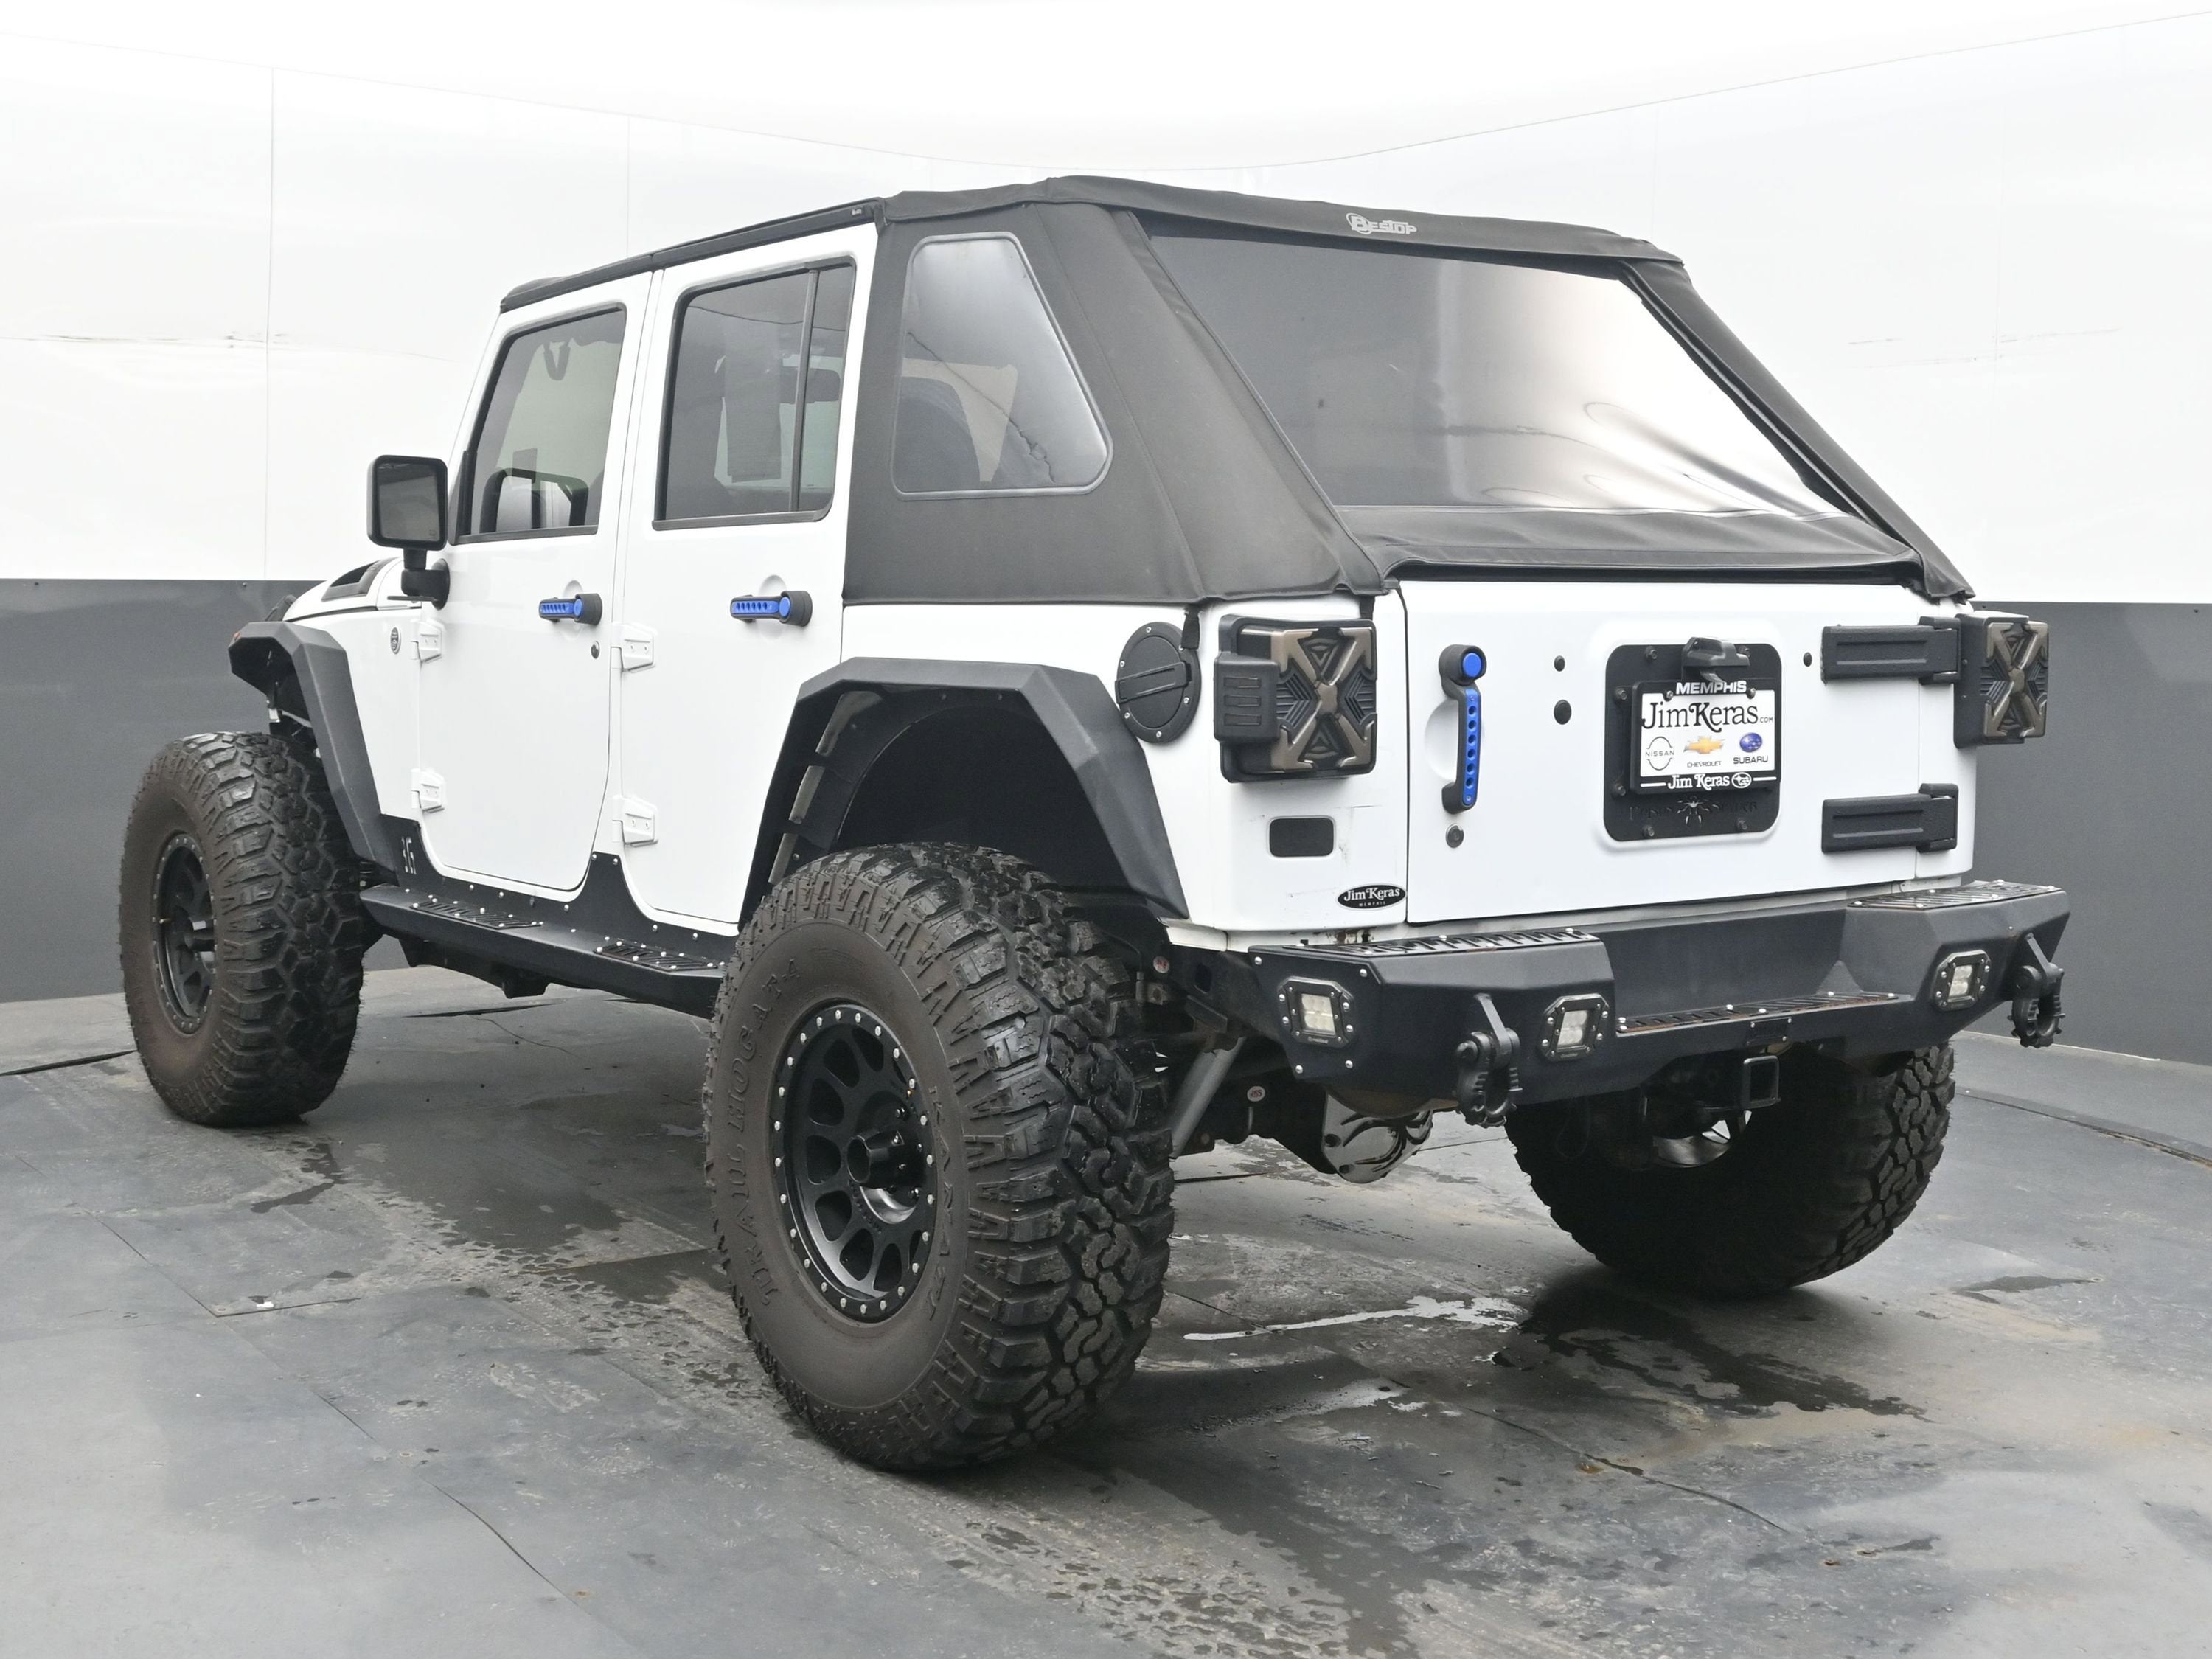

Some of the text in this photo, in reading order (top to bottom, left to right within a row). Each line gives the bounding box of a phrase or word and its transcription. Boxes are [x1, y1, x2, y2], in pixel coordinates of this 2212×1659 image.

[1676, 680, 1747, 695] MEMPHIS
[1733, 756, 1769, 765] SUBARU
[1667, 773, 1730, 790] Jim Keras
[728, 1026, 757, 1131] HOG
